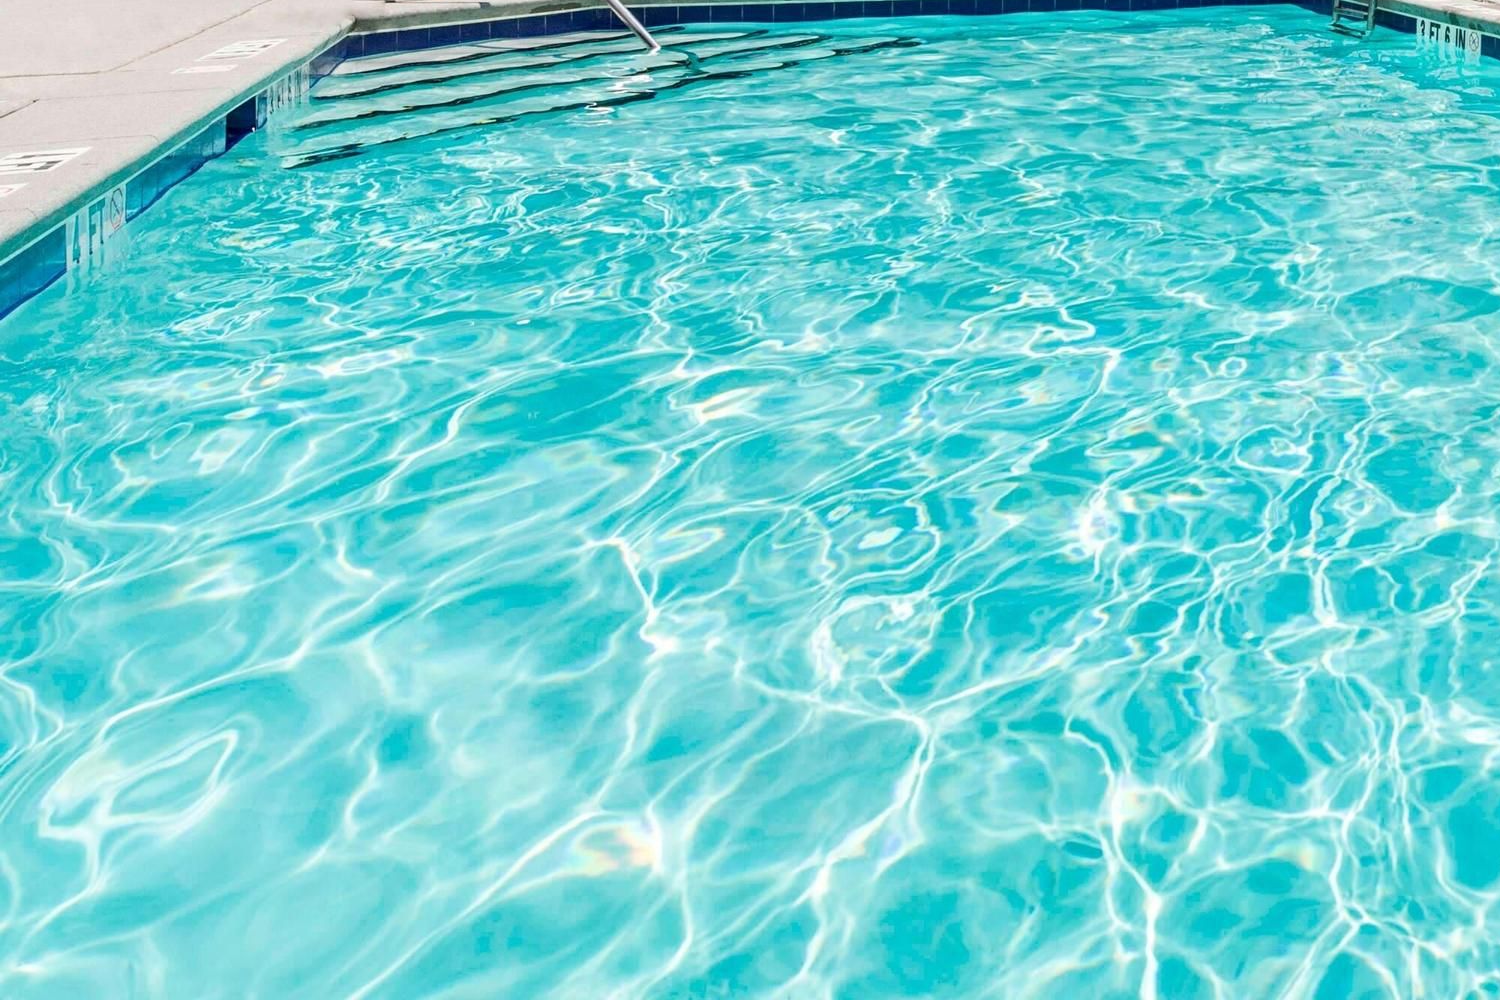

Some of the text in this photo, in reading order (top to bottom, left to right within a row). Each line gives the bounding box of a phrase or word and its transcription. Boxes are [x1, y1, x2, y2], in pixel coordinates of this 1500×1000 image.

[1429, 22, 1441, 41] FT
[1445, 26, 1451, 44] 6
[1455, 28, 1466, 50] IN
[73, 197, 105, 264] 4 FT
